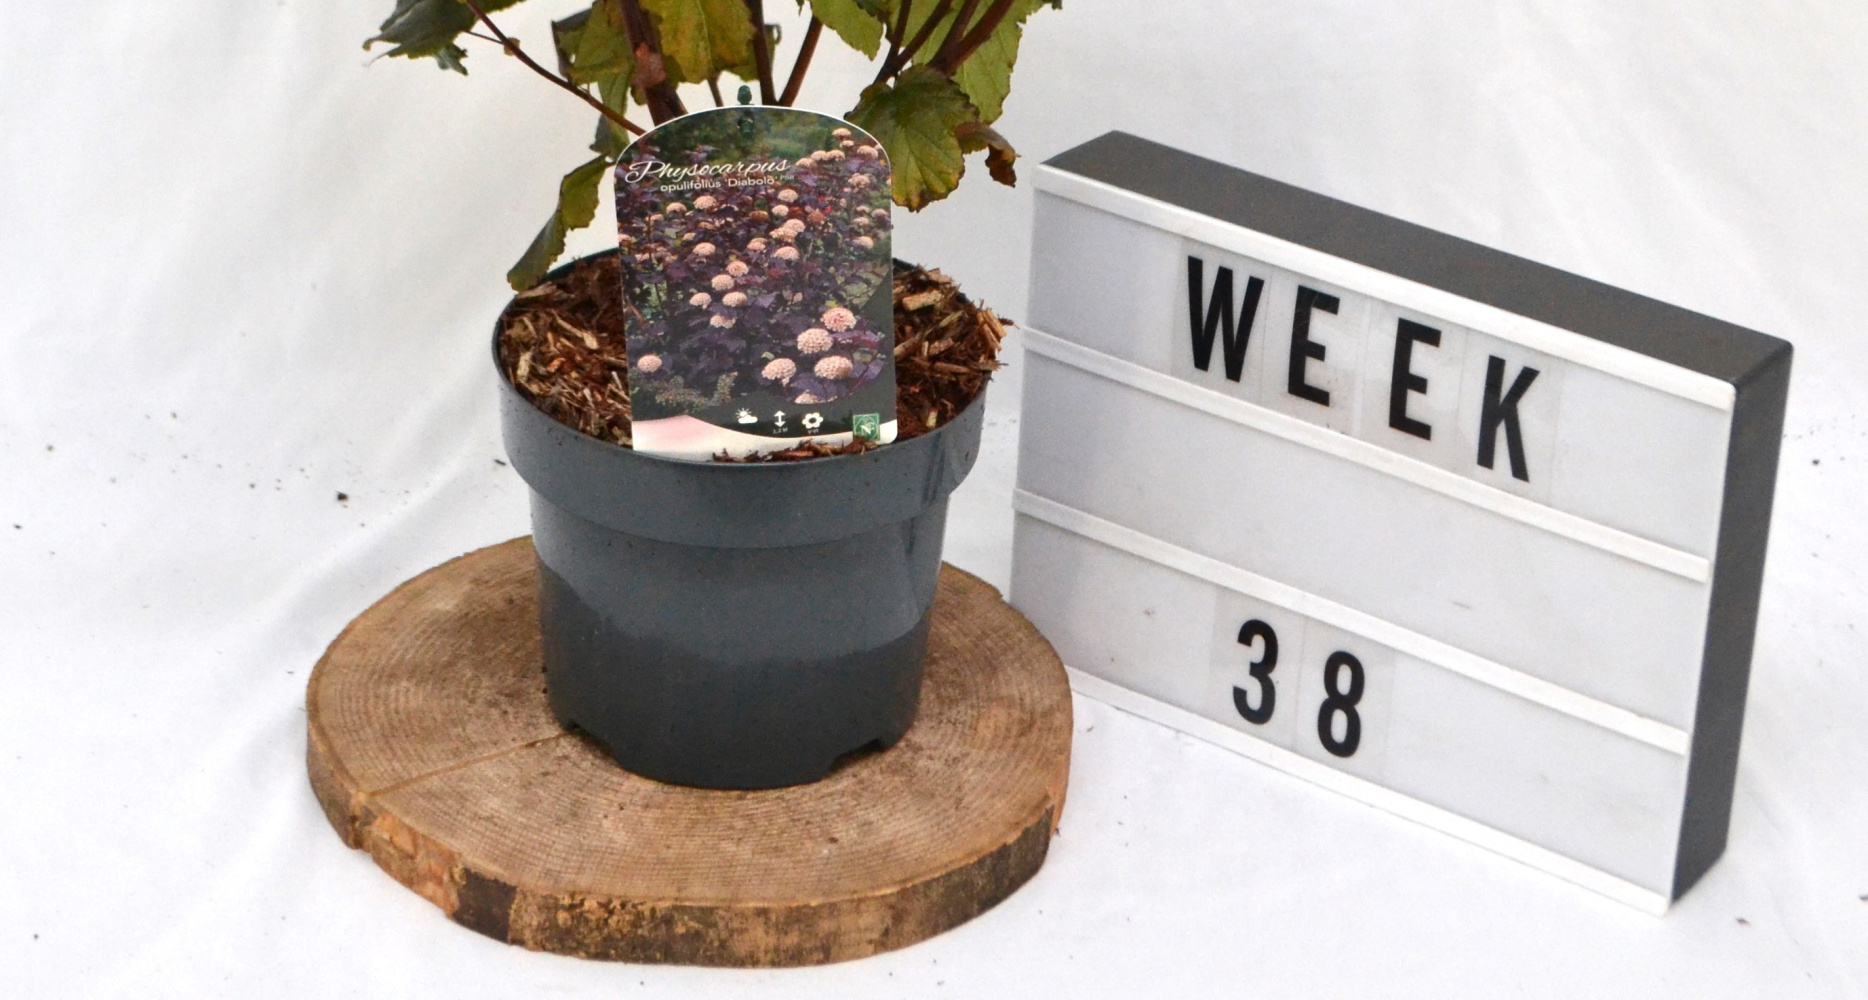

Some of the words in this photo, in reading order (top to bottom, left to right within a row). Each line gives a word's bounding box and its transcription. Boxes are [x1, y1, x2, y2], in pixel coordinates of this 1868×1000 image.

[625, 159, 791, 183] Physocarpus
[660, 180, 722, 193] opulifolius
[1187, 255, 1541, 483] WEEK
[1232, 618, 1365, 758] 38
